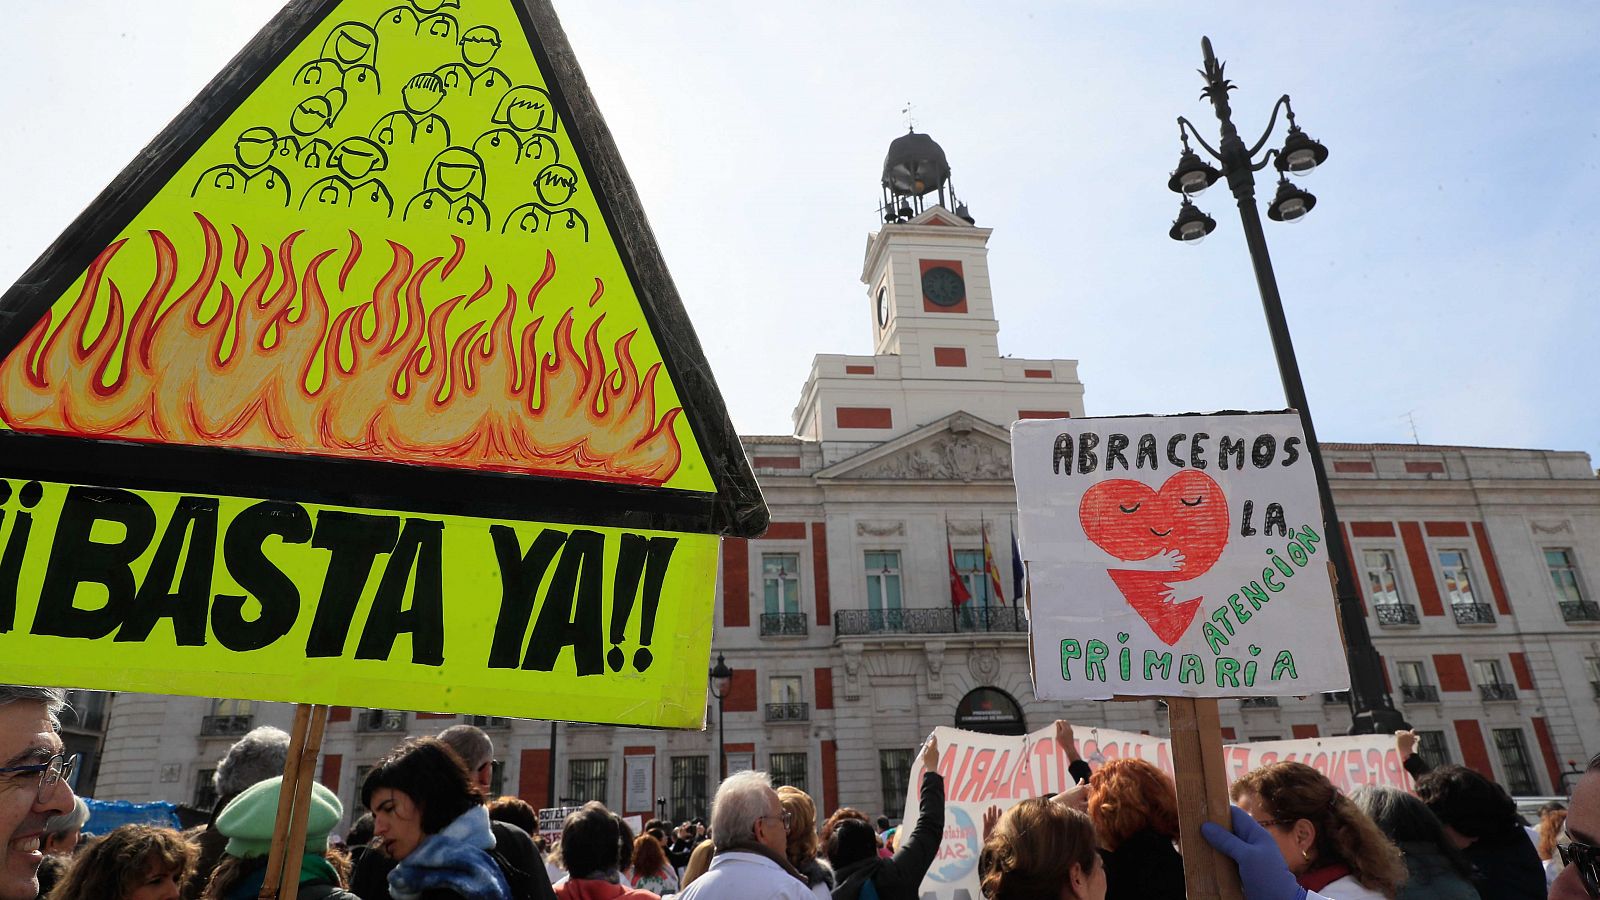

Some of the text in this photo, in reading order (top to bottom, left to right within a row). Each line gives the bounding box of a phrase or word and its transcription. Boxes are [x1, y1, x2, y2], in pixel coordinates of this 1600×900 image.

[1053, 433, 1300, 475] ABRACEMOS
[1241, 500, 1287, 537] LA
[488, 525, 678, 676] YA!!
